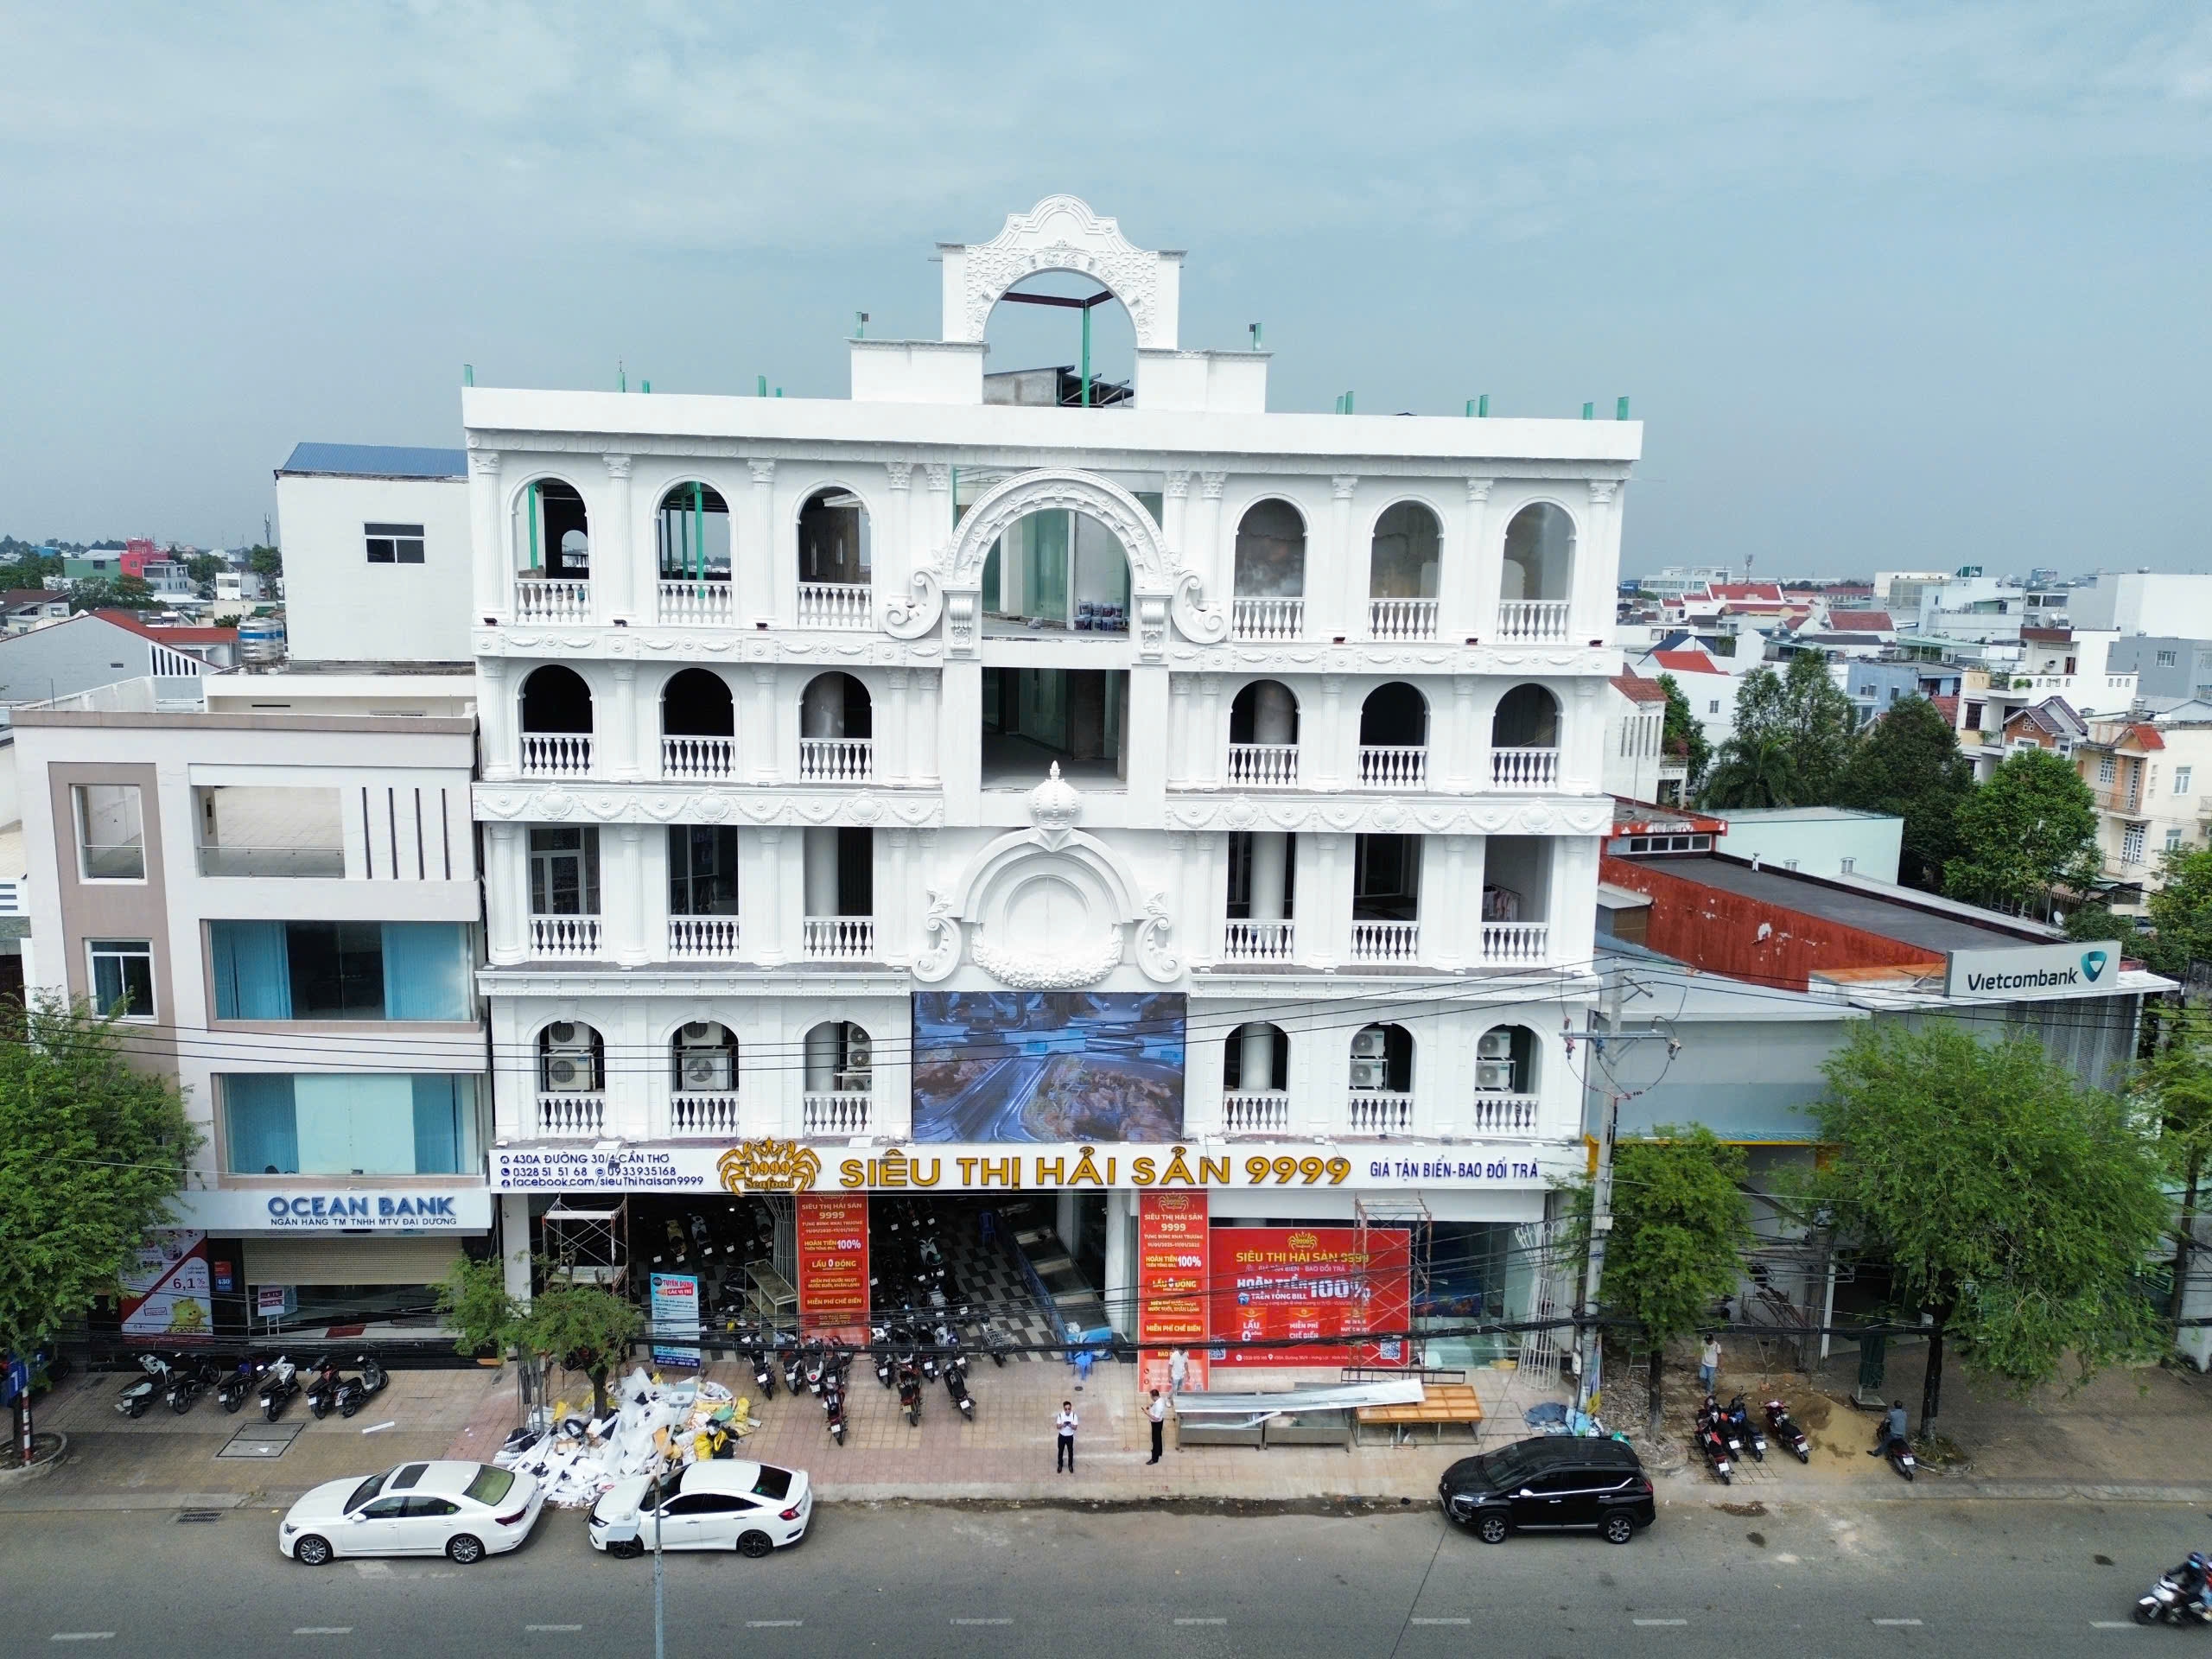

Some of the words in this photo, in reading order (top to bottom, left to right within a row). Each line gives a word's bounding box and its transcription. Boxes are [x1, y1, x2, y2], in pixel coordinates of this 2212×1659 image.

[1967, 967, 2079, 991] Vietcombank
[513, 1154, 541, 1164] 430A
[543, 1152, 588, 1164] ĐƯỜNG
[619, 1150, 644, 1163] CẦN
[647, 1154, 670, 1163] THƠ
[513, 1167, 539, 1177] 0328
[542, 1167, 551, 1177] 51
[557, 1167, 569, 1177] 51
[574, 1166, 588, 1176] 68
[607, 1166, 676, 1176] 0933935168
[749, 1160, 791, 1176] 9999
[839, 1148, 941, 1187] SIÊU
[957, 1157, 1020, 1190] THỊ
[1036, 1146, 1116, 1186] HẢI
[1131, 1146, 1230, 1186] SẢN
[1245, 1156, 1351, 1185] 9999
[1370, 1157, 1390, 1177] GIÁ
[1395, 1158, 1419, 1181] TẬN
[1487, 1157, 1507, 1179] ĐỔI
[1512, 1158, 1538, 1178] TRẢ
[745, 1177, 795, 1192] Seafood
[268, 1196, 368, 1217] OCEAN
[378, 1196, 456, 1217] BANK
[270, 1217, 297, 1226] NGÂN
[302, 1217, 328, 1226] HÀNG
[403, 1218, 419, 1228] ĐẠI
[423, 1217, 456, 1226] DƯƠNG
[1161, 1223, 1186, 1231] 9999
[836, 1238, 861, 1249] 100%
[828, 1258, 834, 1268] 0
[1178, 1255, 1202, 1268] 100%
[1236, 1250, 1263, 1262] SIÊU
[1266, 1252, 1286, 1264] THỊ
[1289, 1249, 1310, 1262] HẢI
[1313, 1249, 1338, 1263] SẢN
[173, 1278, 196, 1291] 6,1
[1272, 1290, 1291, 1300] TỔNG
[1243, 1319, 1260, 1330] LẨU
